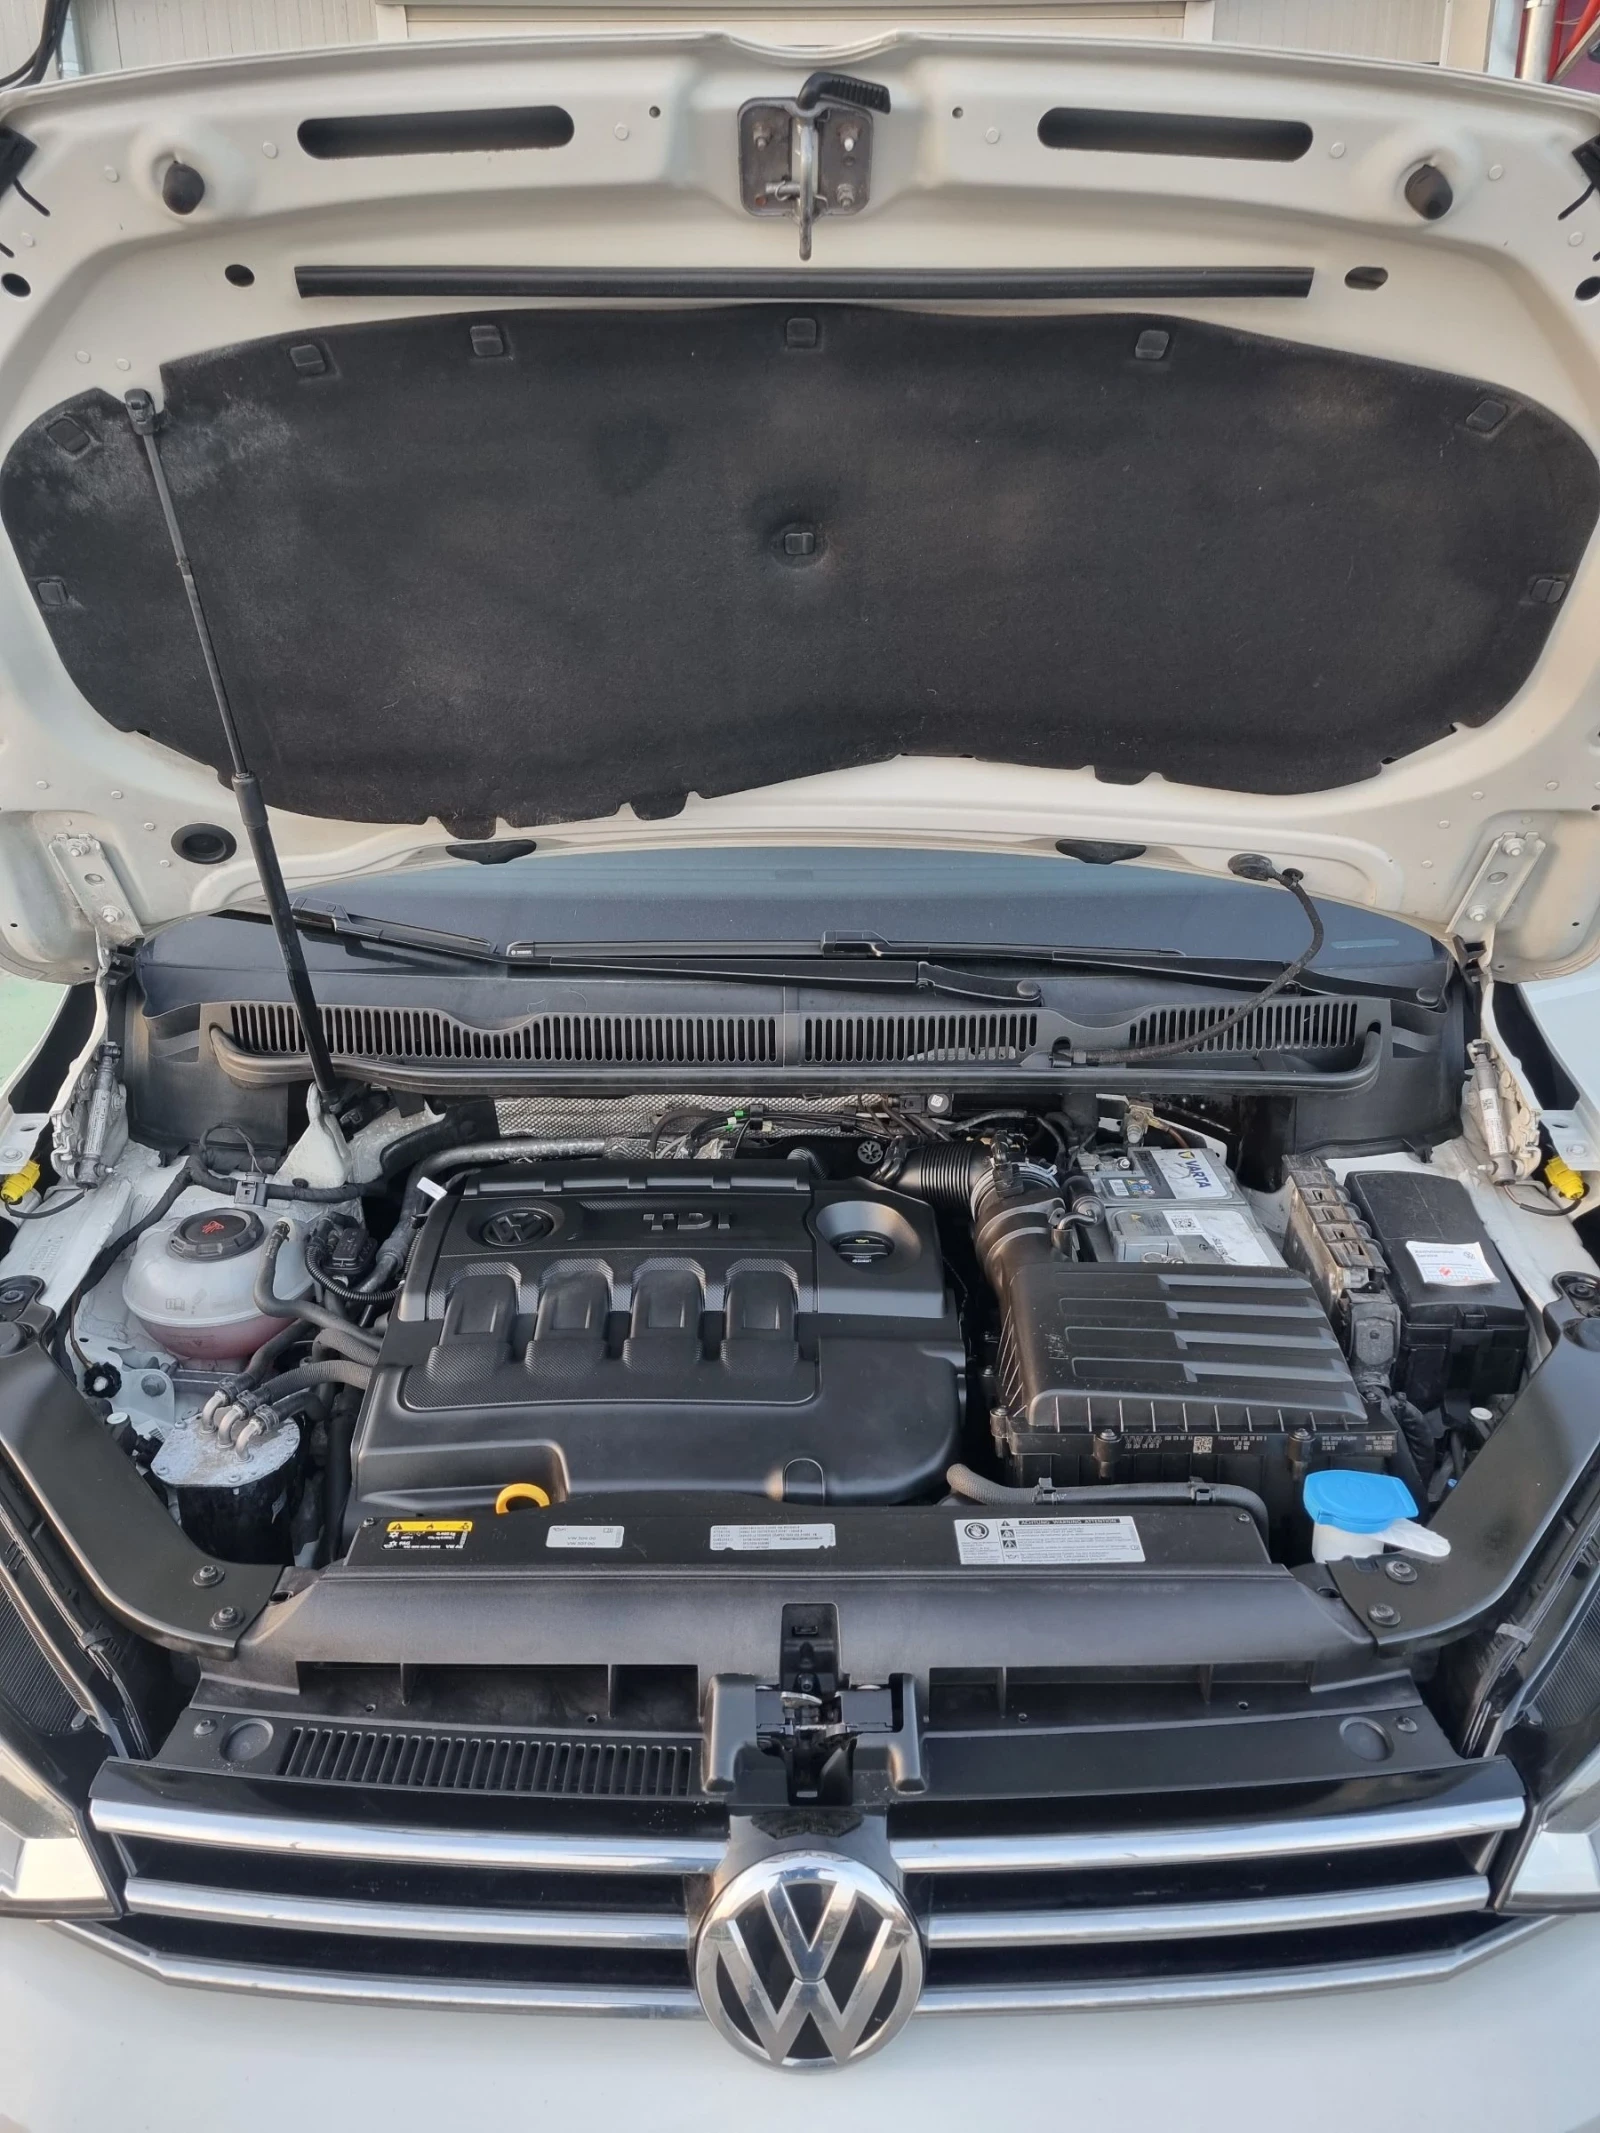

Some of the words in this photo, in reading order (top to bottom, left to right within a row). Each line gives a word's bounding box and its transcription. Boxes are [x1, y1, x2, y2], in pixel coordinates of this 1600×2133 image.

[1185, 1160, 1212, 1188] VARTA
[643, 1213, 730, 1230] TDI
[706, 1865, 913, 2070] VW
